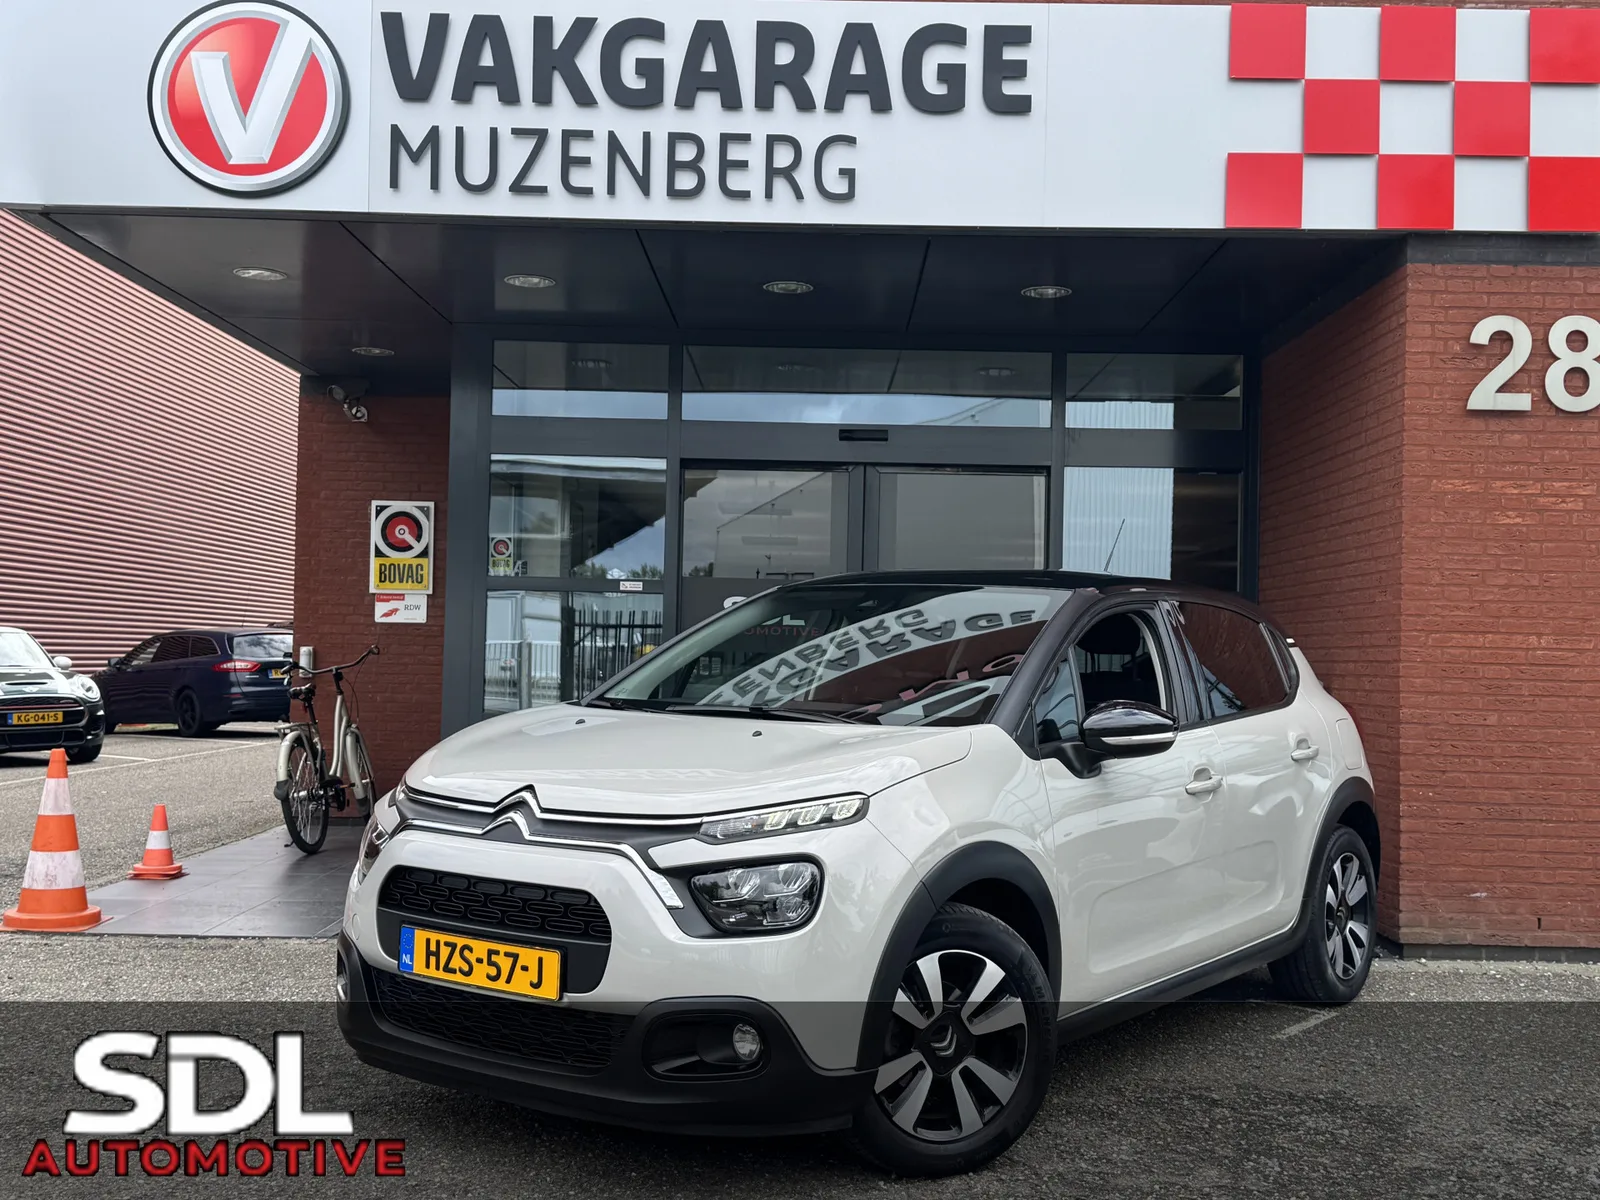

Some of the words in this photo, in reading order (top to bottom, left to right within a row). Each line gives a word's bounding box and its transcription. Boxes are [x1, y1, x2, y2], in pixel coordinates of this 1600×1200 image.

[379, 11, 1033, 115] VAKGARAGE
[388, 123, 858, 202] MUZENBERG
[1466, 314, 1600, 413] 28
[378, 562, 424, 585] BOVAG
[16, 712, 59, 723] KG-041-S
[402, 952, 413, 965] NL
[424, 937, 544, 990] HZS-57-J
